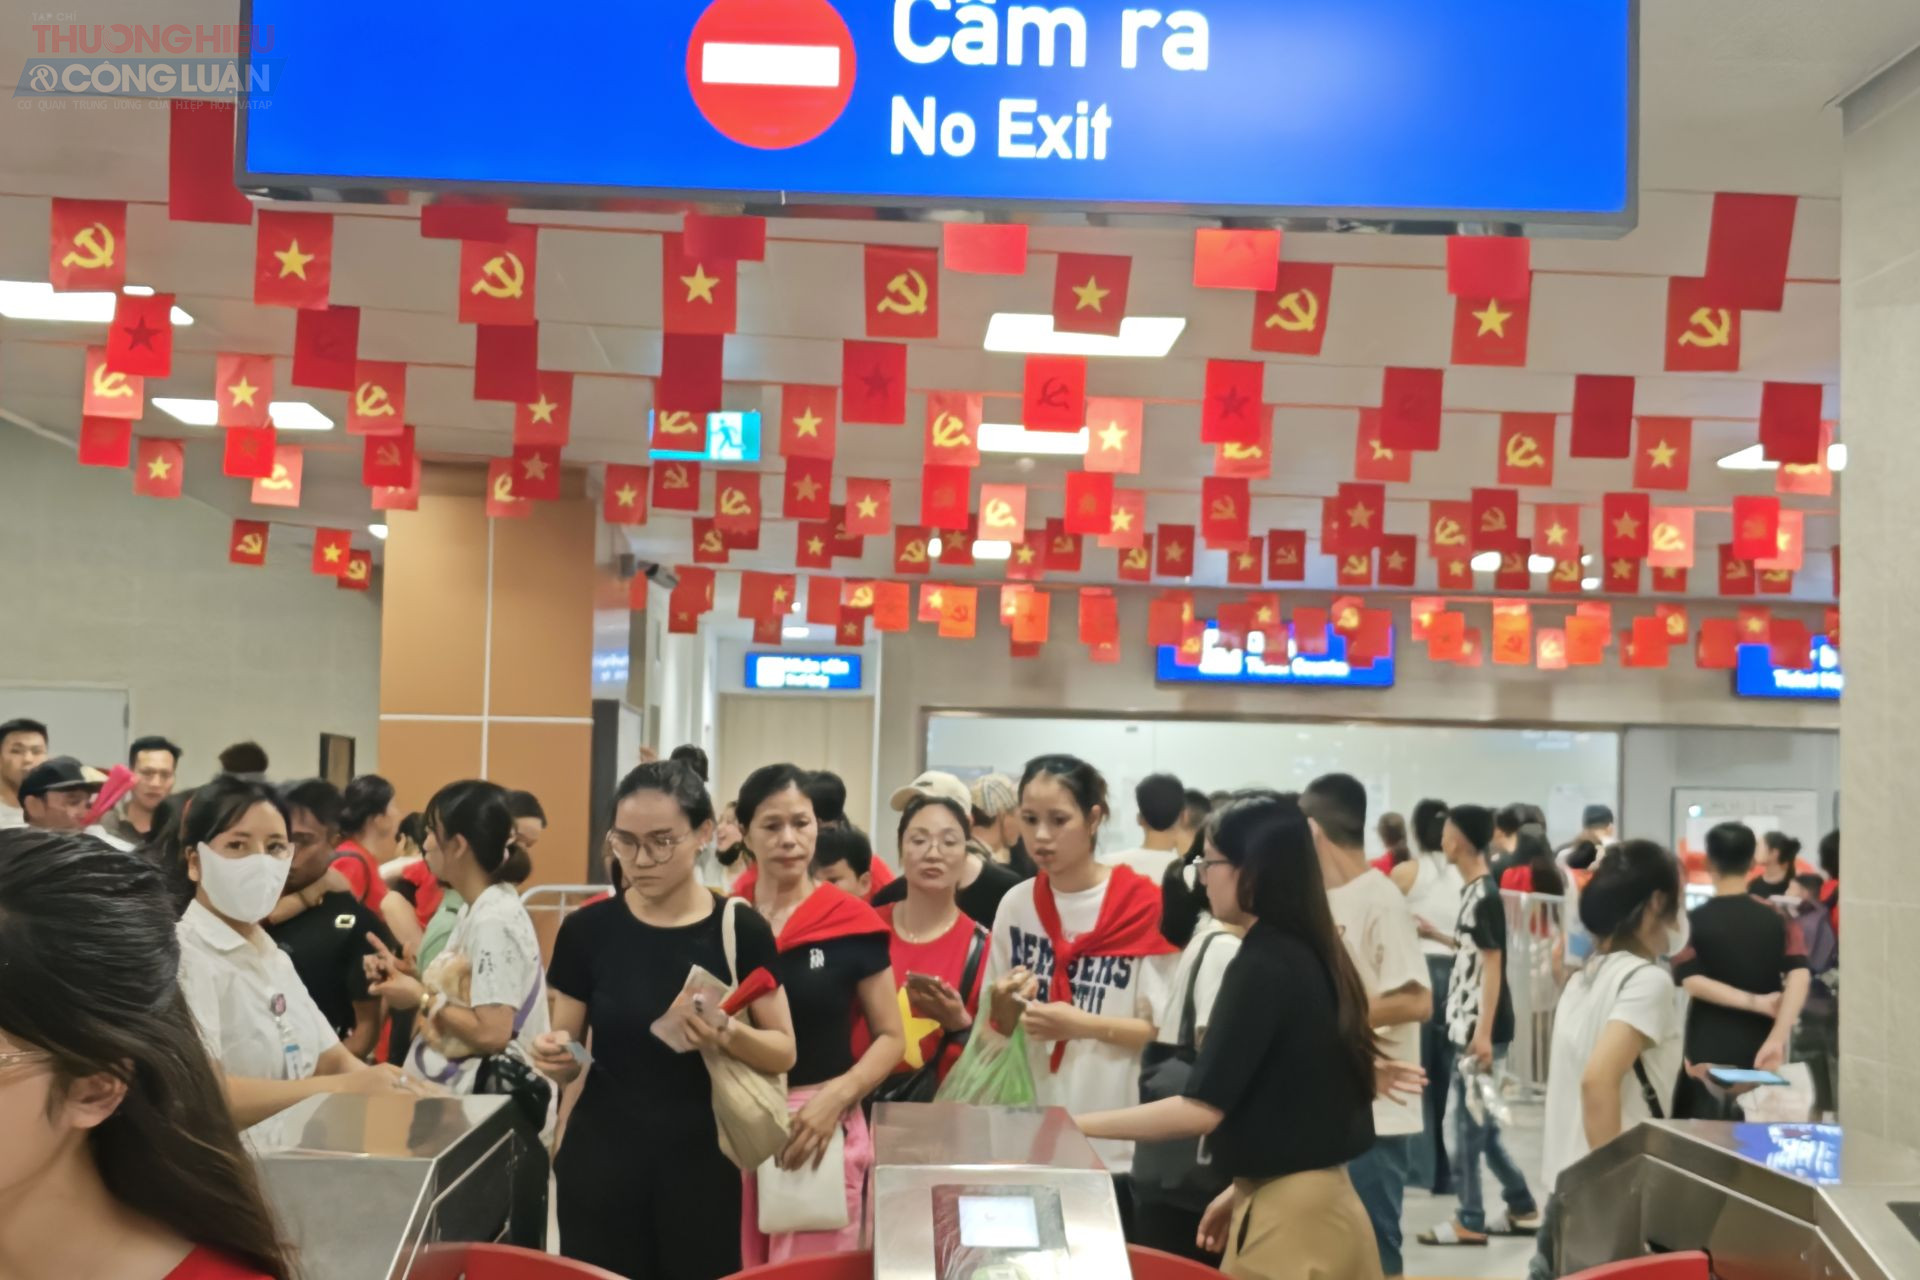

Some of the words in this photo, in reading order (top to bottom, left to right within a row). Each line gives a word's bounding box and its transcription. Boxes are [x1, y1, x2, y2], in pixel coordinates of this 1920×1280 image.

[1121, 9, 1209, 70] ra
[891, 96, 976, 157] No
[998, 99, 1112, 159] Exit
